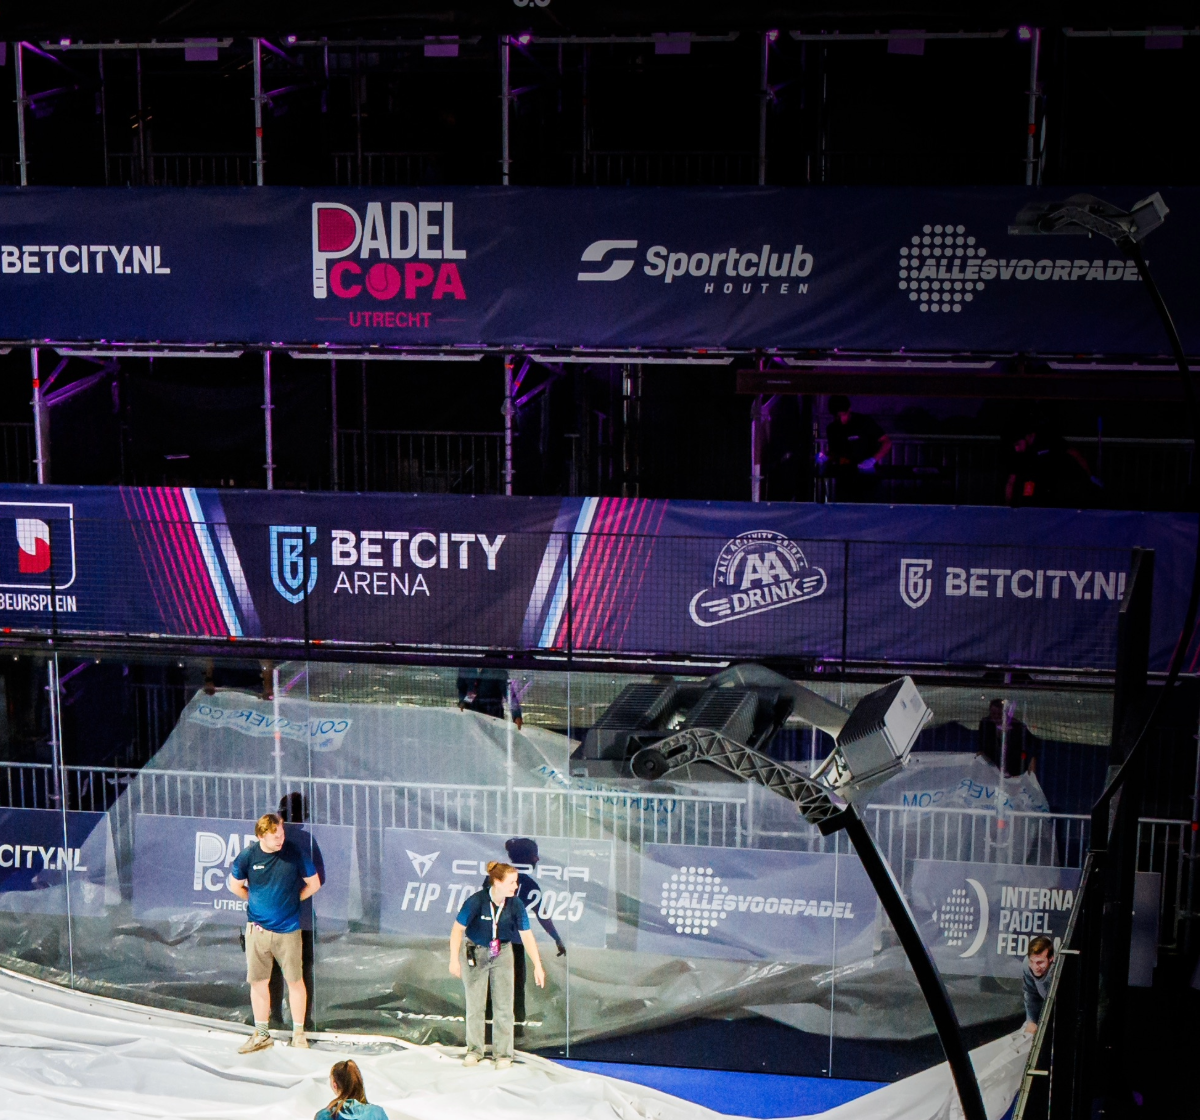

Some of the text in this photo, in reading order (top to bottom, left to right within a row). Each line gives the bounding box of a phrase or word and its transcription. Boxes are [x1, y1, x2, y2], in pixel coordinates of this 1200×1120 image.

[312, 201, 467, 265] PADEL
[1, 244, 171, 275] BETCITY.NL
[643, 244, 814, 283] Sportclub
[329, 261, 467, 300] COPA
[704, 282, 810, 294] HOUTEN
[348, 311, 432, 329] UTRECHT
[330, 529, 506, 571] BETCITY
[333, 571, 431, 597] ARENA
[740, 550, 793, 590] AA
[731, 578, 803, 613] DRINK
[401, 881, 441, 912] FIP
[524, 889, 587, 922] 2025
[676, 893, 855, 919] ALLESVOORPADEL
[1001, 886, 1074, 911] INTERNA
[999, 910, 1053, 934] PADEL
